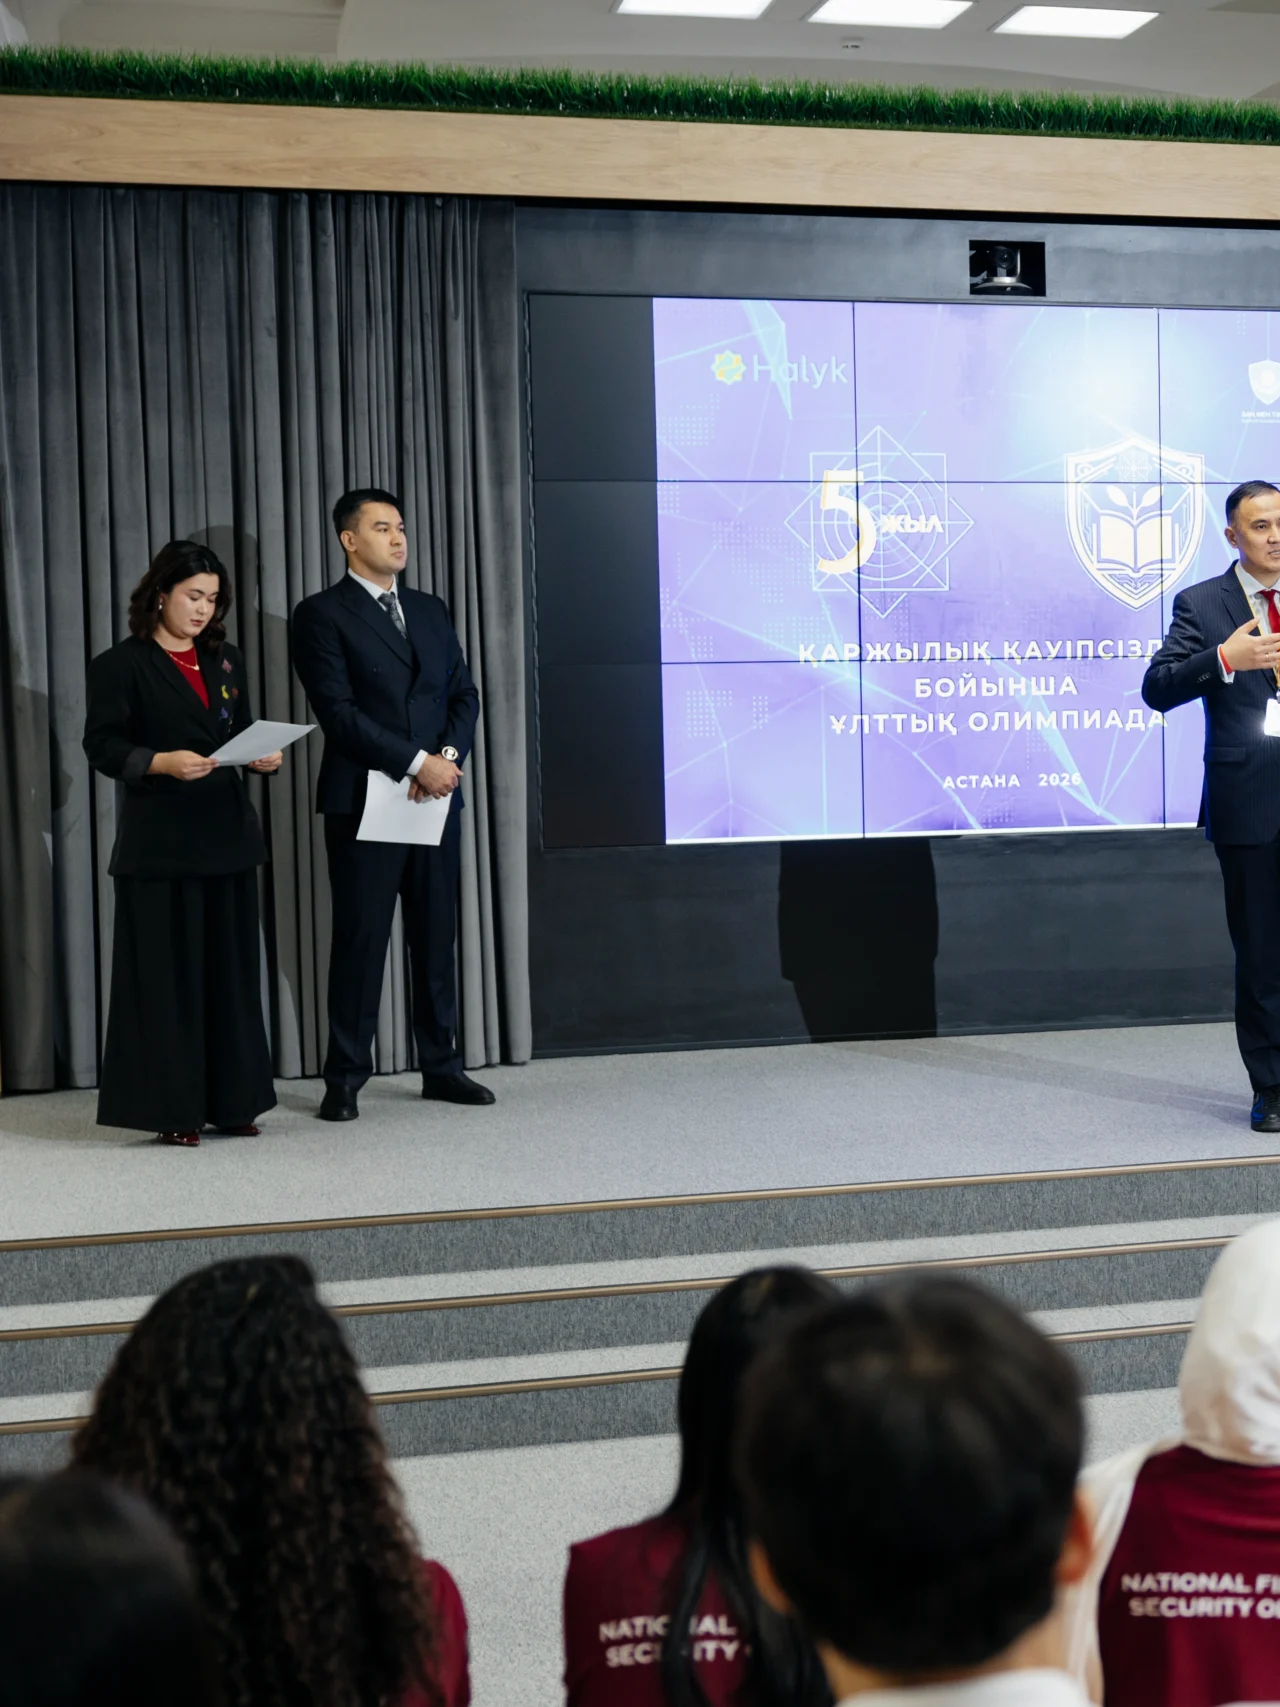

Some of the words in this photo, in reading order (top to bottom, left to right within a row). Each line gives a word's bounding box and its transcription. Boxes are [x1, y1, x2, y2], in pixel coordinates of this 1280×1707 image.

[753, 354, 848, 389] Halyk
[818, 469, 877, 575] 5
[881, 514, 944, 533] ЖЫЛ
[799, 641, 992, 668] ҚАРЖЫЛЫҚ
[1003, 638, 1163, 665] ҚАУІПСІЗД
[915, 672, 1078, 698] БОЙЫНША
[829, 712, 958, 735] ҰЛТТЫҚ
[968, 708, 1168, 733] ОЛИМПИАДА
[942, 774, 1021, 789] АСТАНА
[1038, 772, 1081, 787] 2026
[1121, 1572, 1251, 1594] NATIONAL
[1129, 1597, 1253, 1618] SECURITY
[605, 1640, 740, 1669] SECITY
